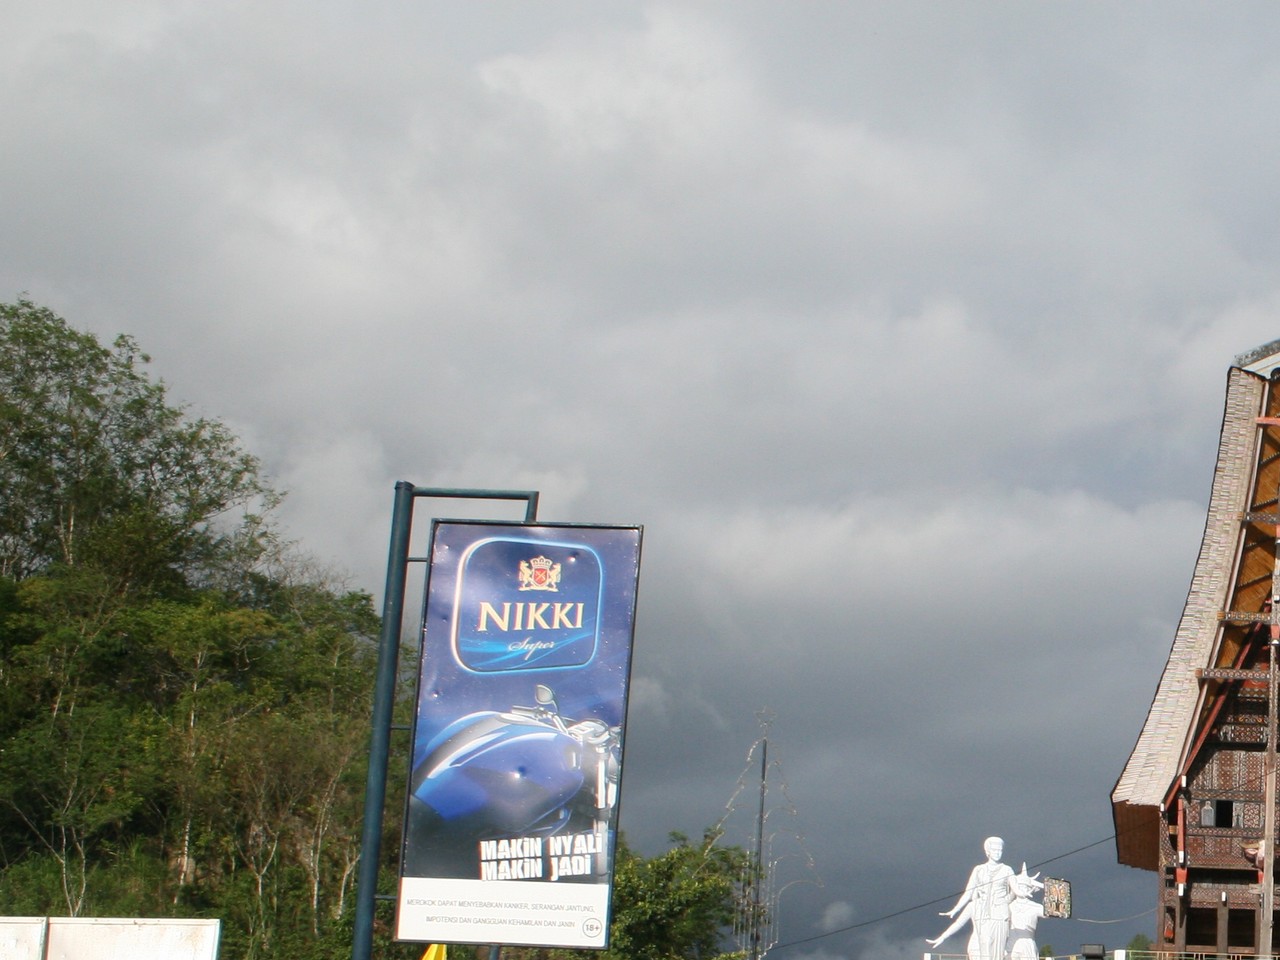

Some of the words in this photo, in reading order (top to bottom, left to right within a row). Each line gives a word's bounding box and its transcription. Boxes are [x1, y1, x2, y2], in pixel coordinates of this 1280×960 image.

[477, 601, 585, 632] NIKKI
[508, 637, 555, 660] Super
[407, 899, 437, 907] MEROKOK
[437, 900, 457, 908] DAPAT
[458, 900, 503, 909] MENYEBABKAN
[531, 903, 564, 911] SERANGAN
[426, 916, 458, 924] IMPOTENSI
[473, 917, 507, 925] GANGGUAN
[508, 918, 542, 926] KEHAMILAN
[557, 920, 575, 928] JANIN
